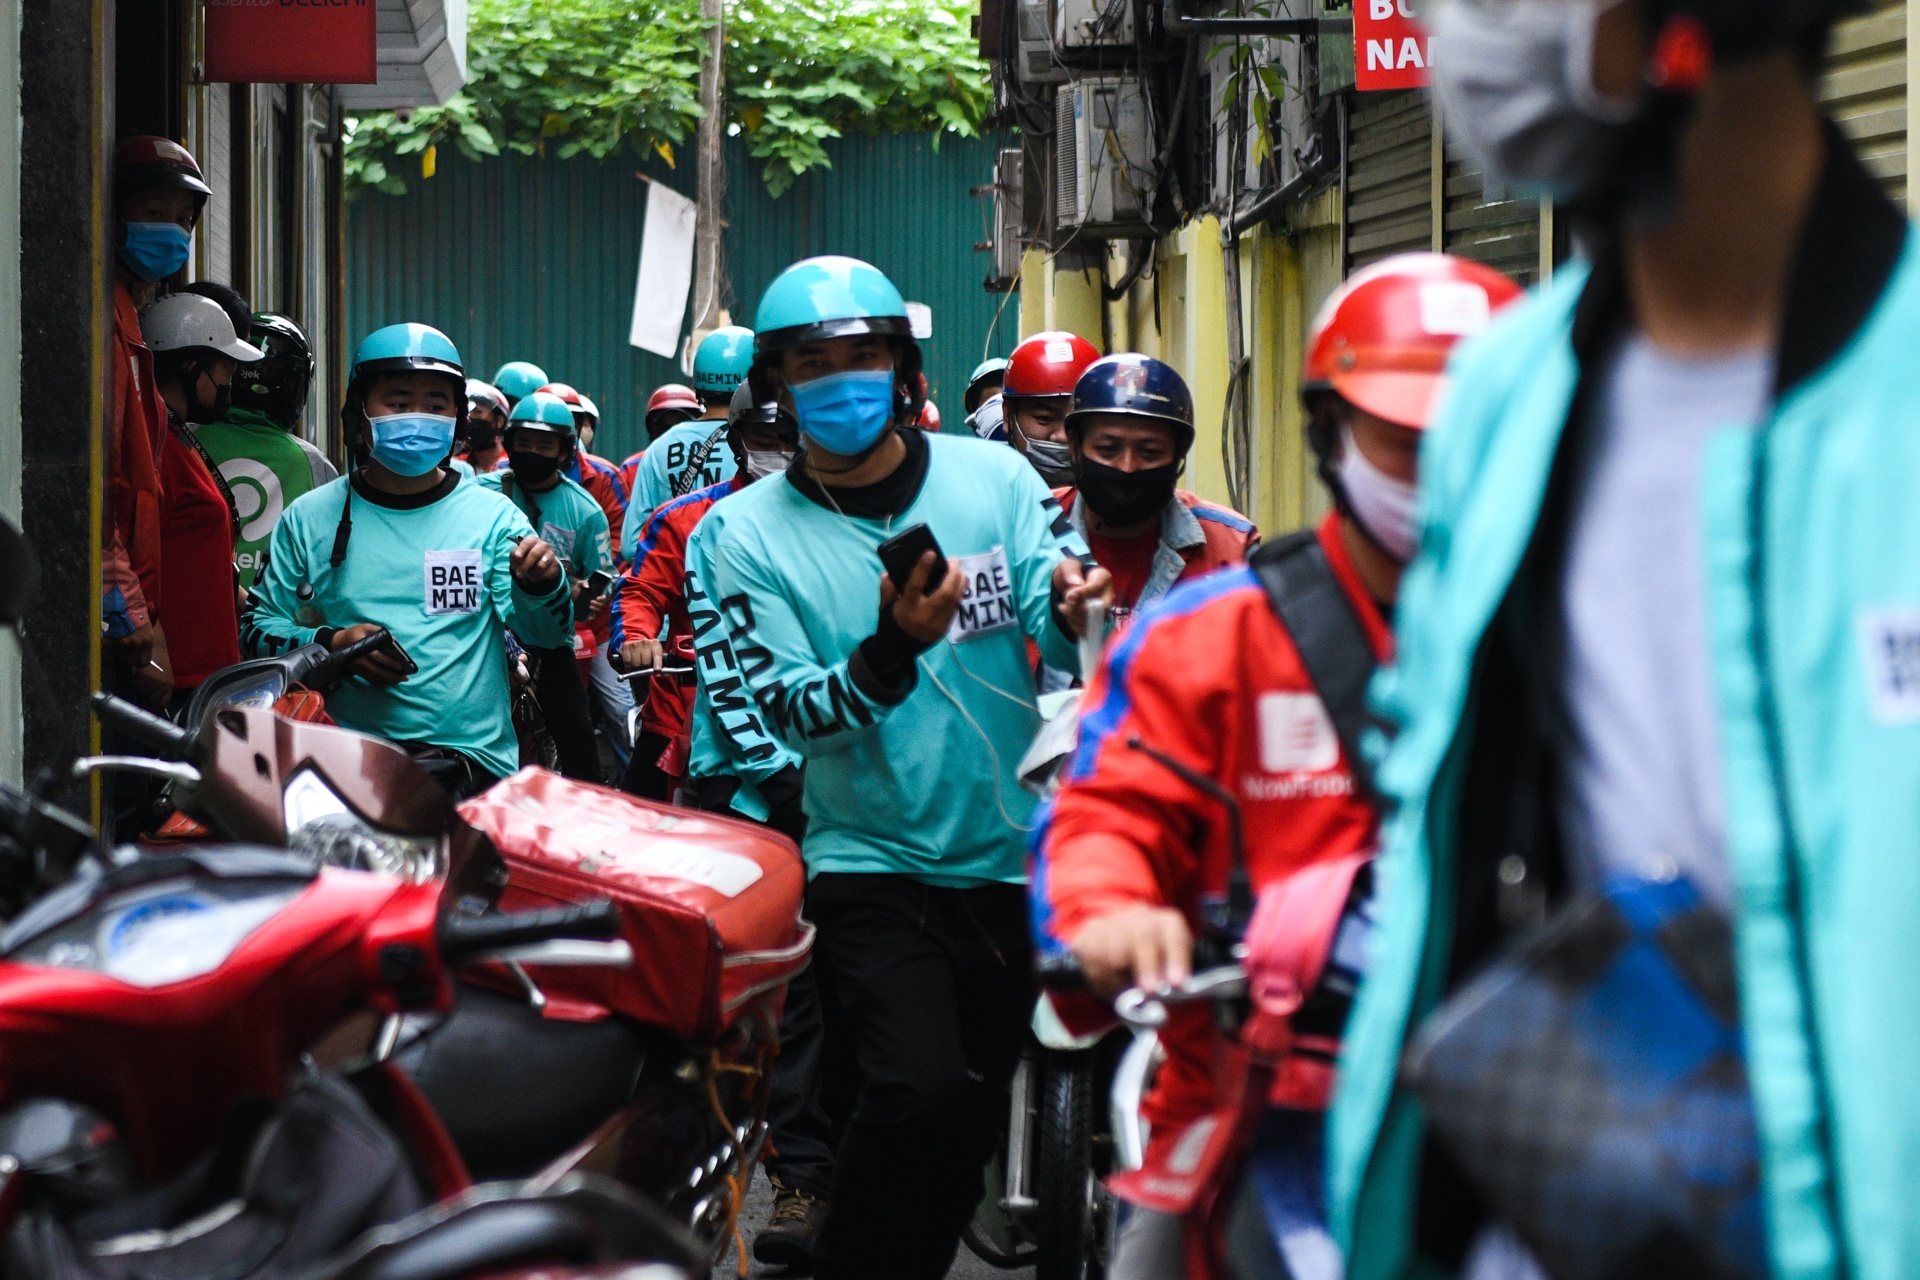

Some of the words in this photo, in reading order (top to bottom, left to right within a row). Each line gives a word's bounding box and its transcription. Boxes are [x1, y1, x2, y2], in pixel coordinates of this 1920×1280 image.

[697, 371, 742, 385] BAEMIN
[431, 565, 478, 586] BAE
[432, 588, 477, 609] MIN
[958, 594, 1016, 631] MIN
